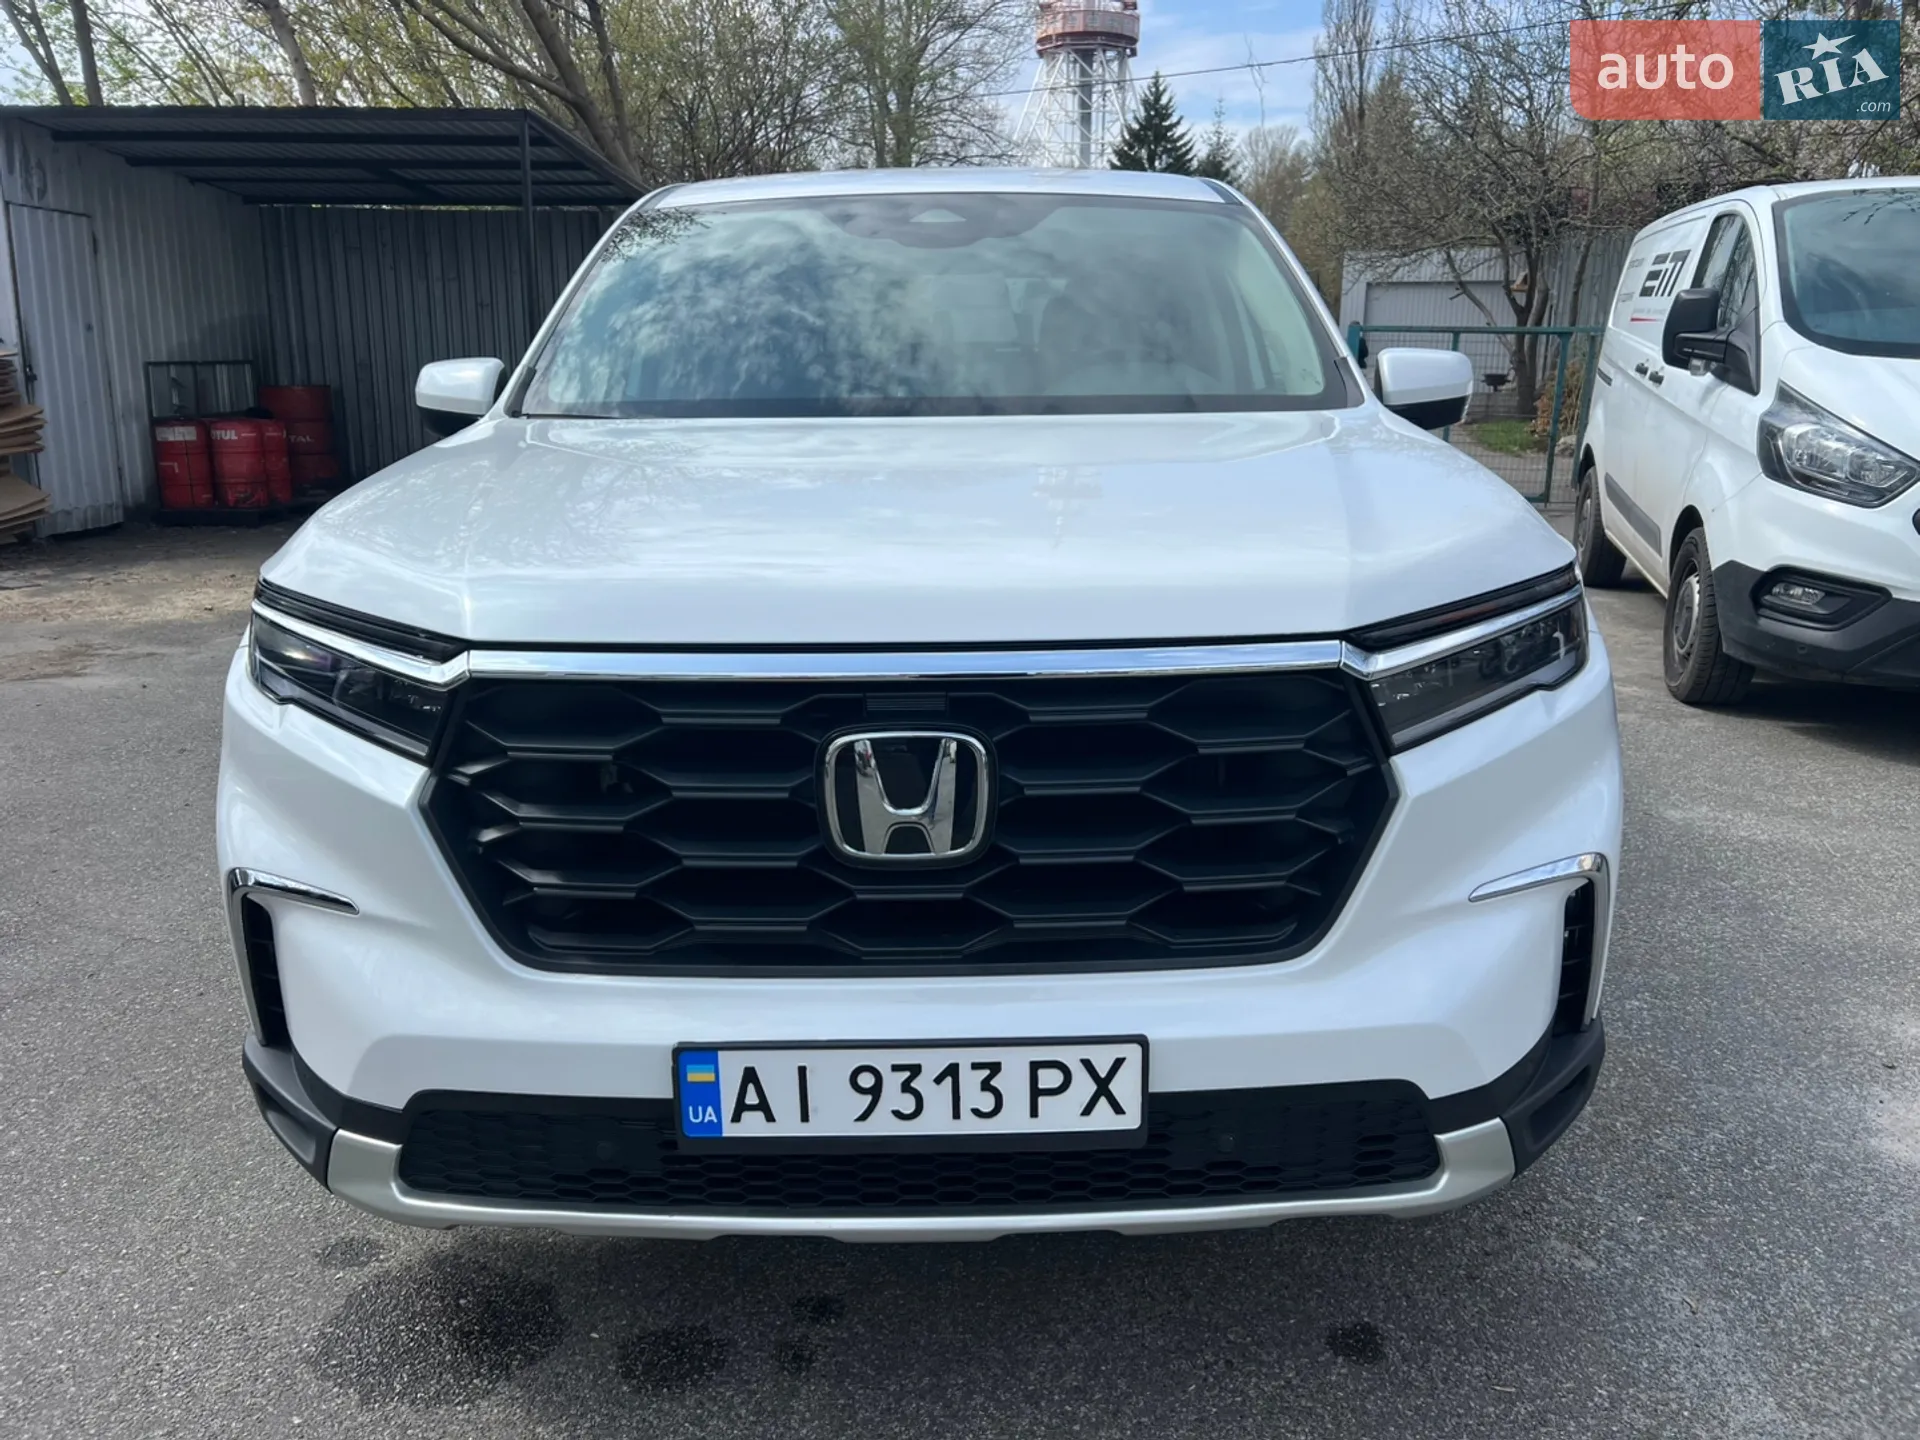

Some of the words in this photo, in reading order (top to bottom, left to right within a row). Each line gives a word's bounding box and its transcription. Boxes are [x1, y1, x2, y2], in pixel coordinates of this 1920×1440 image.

[849, 1061, 1004, 1122] 9313
[1029, 1057, 1127, 1118] PX
[689, 1106, 718, 1123] UA
